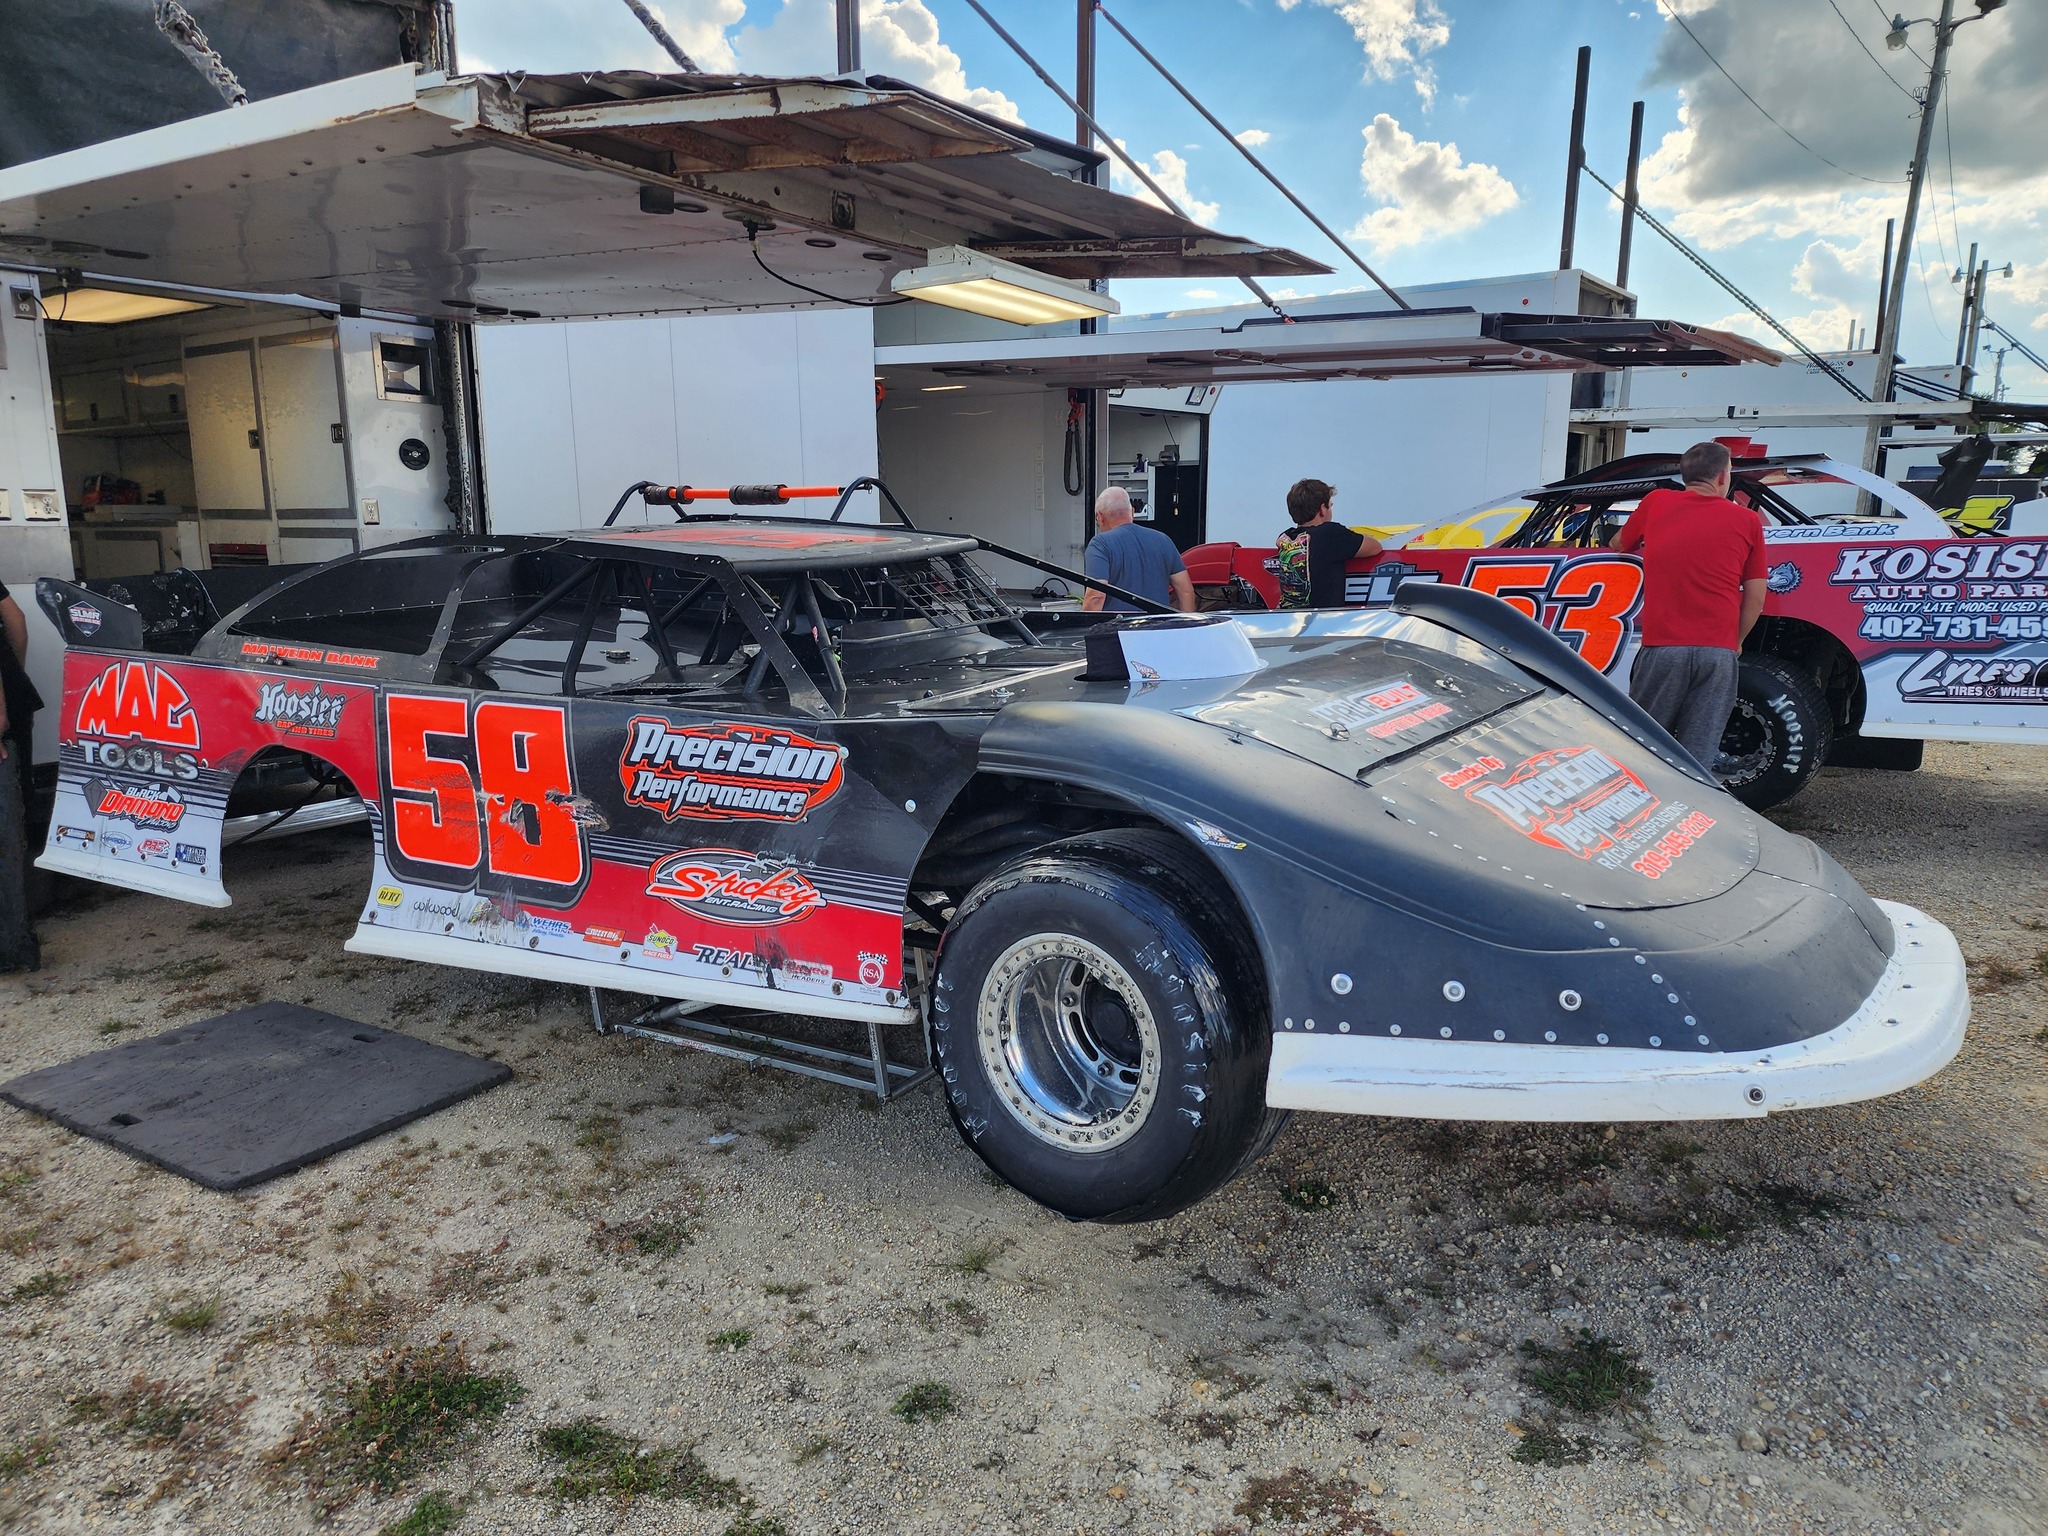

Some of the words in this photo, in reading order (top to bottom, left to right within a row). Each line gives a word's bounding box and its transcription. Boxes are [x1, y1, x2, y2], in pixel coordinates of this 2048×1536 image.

[1823, 523, 1898, 537] Bank
[1852, 585, 1957, 598] AUTO
[1462, 557, 1644, 674] 53
[1867, 602, 1921, 613] QUALITY
[1924, 602, 1953, 612] LATE
[1958, 602, 2000, 612] MODEL
[2001, 602, 2037, 612] USED
[325, 652, 379, 668] BANK
[76, 660, 200, 750] MAC
[255, 681, 345, 726] Hoosier
[1363, 683, 1423, 709] BUILT
[1948, 686, 1983, 696] TIRES
[1985, 685, 1999, 697] &
[2001, 686, 2048, 697] WHEELS
[308, 728, 335, 737] TIRES
[1767, 693, 1804, 774] Hoosier
[78, 739, 199, 781] TOOLS
[630, 723, 839, 781] Precision
[1437, 763, 1490, 790] Shocks
[1477, 755, 1507, 770] By
[126, 786, 161, 801] BLACK
[386, 693, 584, 885] 58
[633, 771, 808, 818] Performance
[1471, 749, 1621, 827] Precision
[97, 789, 185, 822] DIAMOND
[1544, 781, 1652, 852] Performance
[1597, 836, 1641, 870] RACING
[1630, 800, 1689, 844] SUSPENSIONS
[1630, 811, 1717, 880] 319-545-2212
[378, 890, 402, 903] BERT
[649, 864, 823, 914] Stuckey
[413, 898, 461, 917] wilwood
[532, 917, 571, 929] WEHRS
[643, 949, 658, 957] RACE
[658, 951, 674, 960] FUELS
[648, 934, 675, 945] SUNOCO
[693, 944, 756, 971] REAL
[863, 967, 880, 979] RSA
